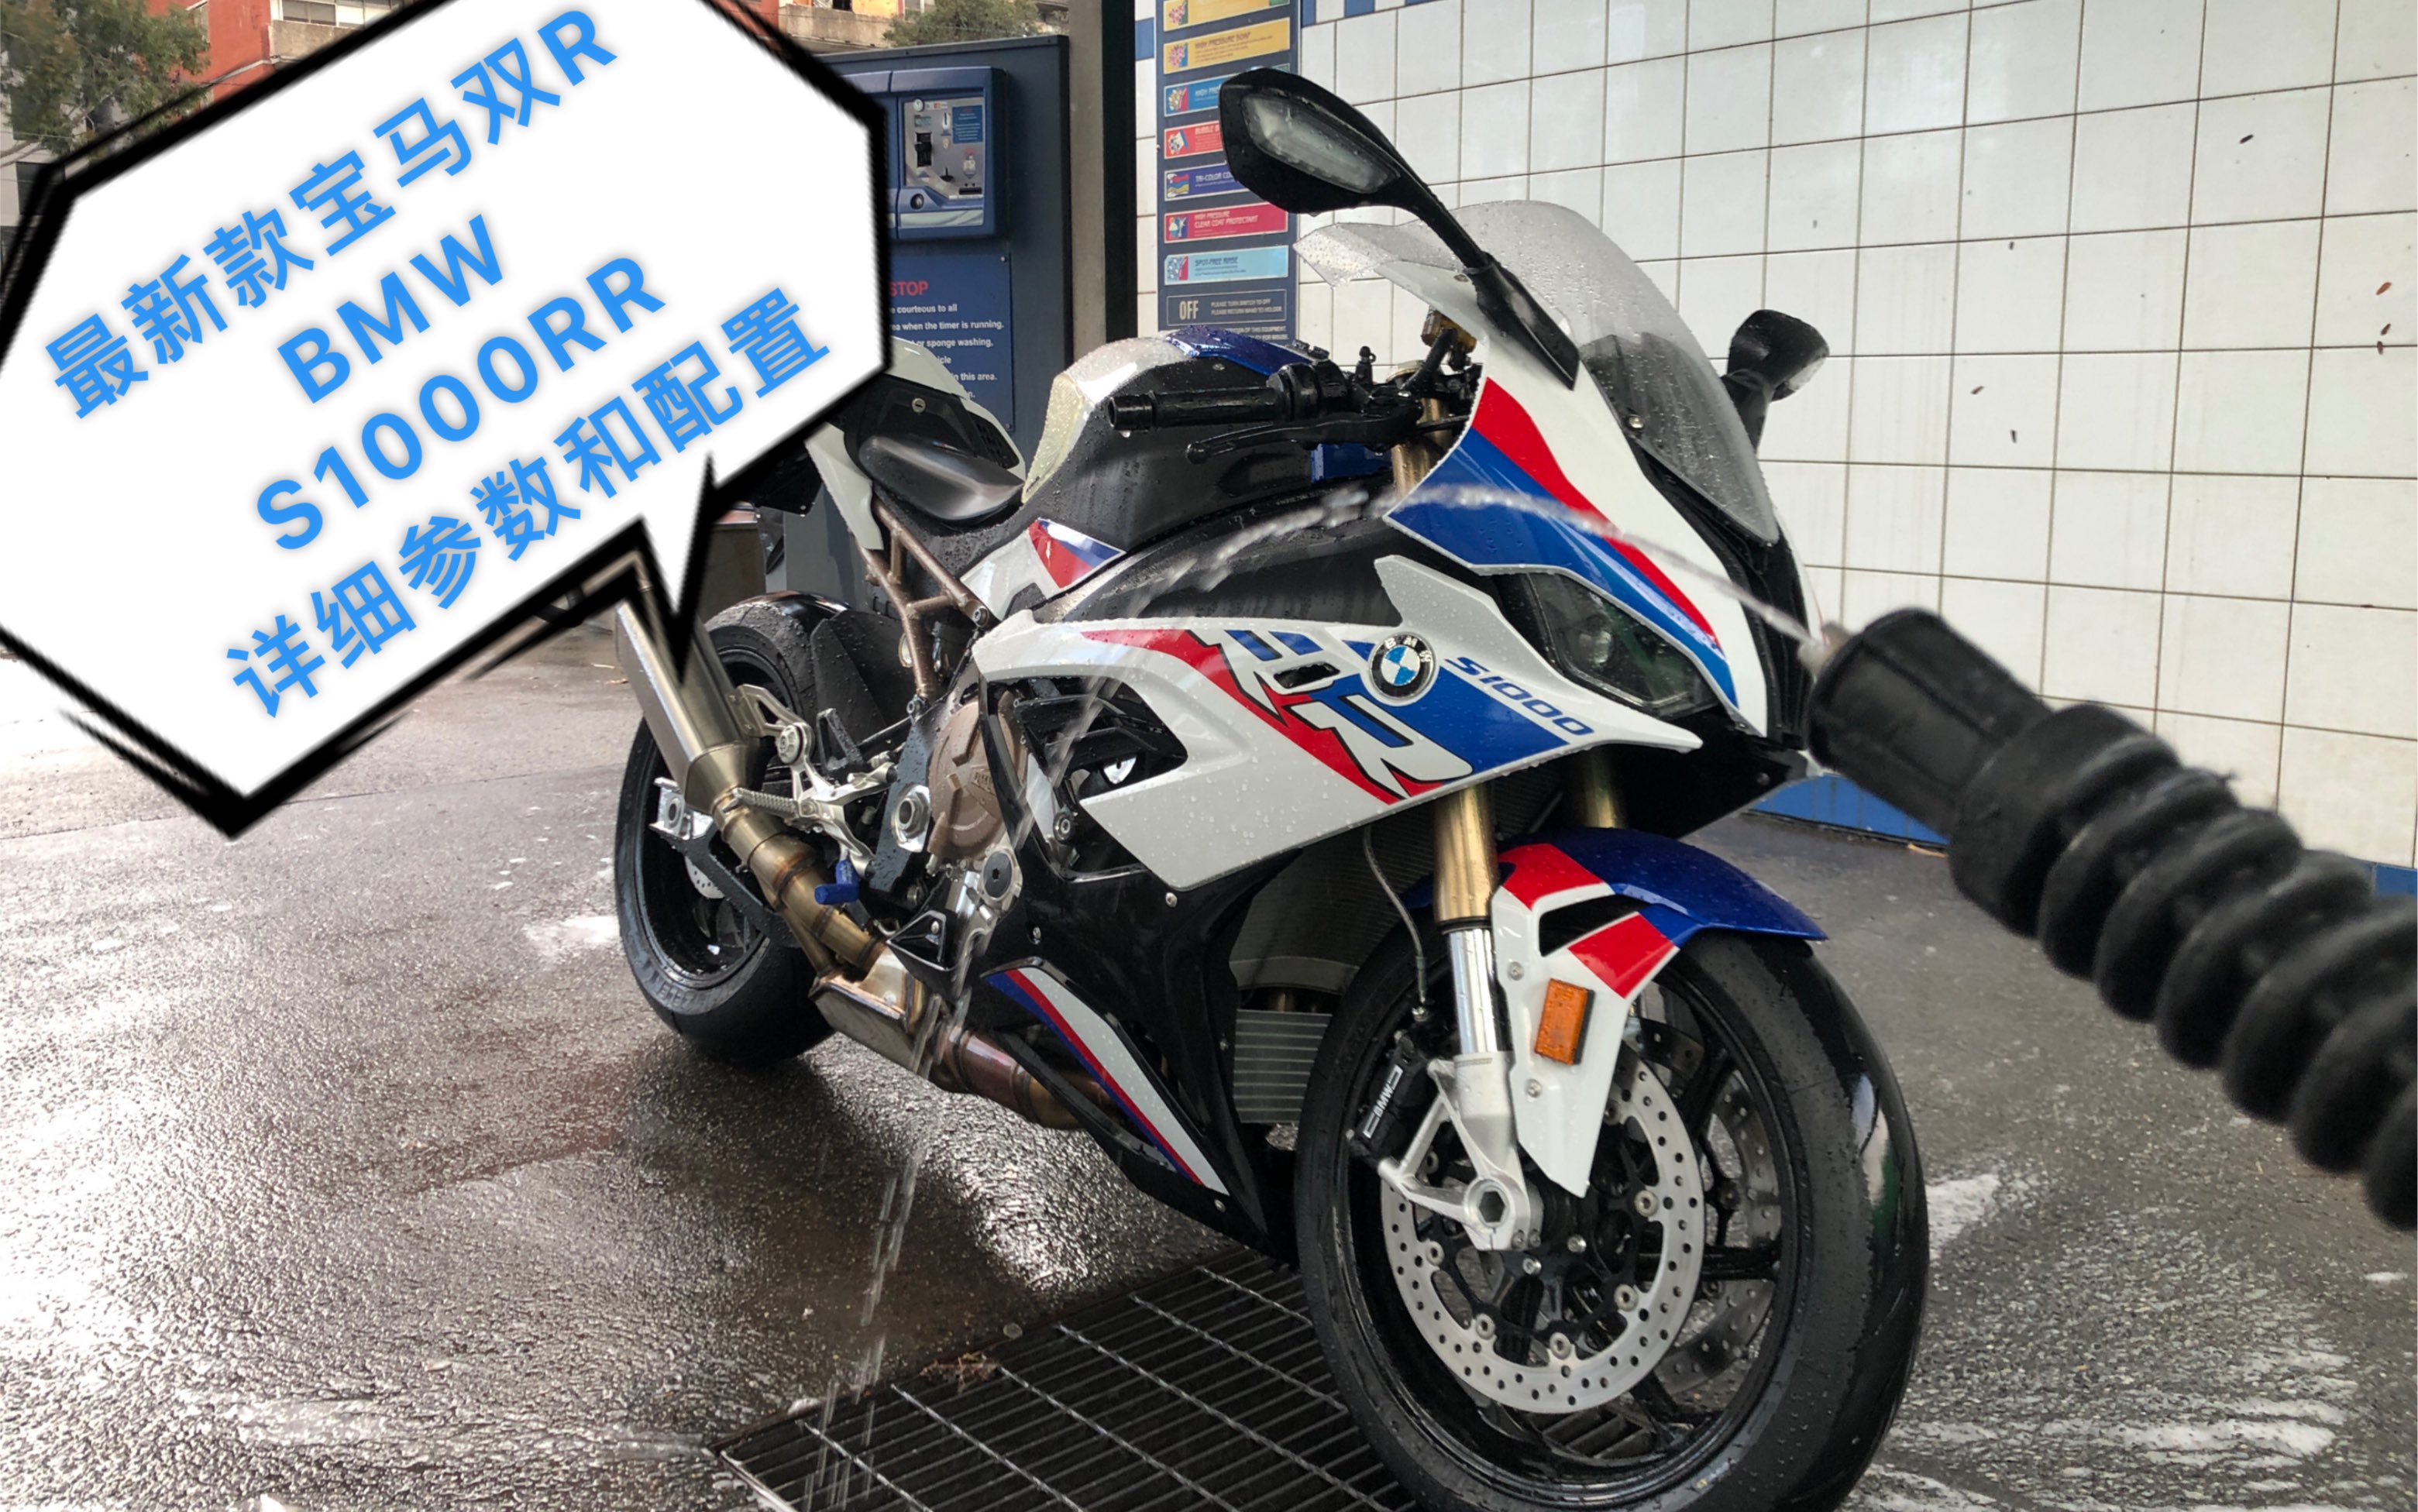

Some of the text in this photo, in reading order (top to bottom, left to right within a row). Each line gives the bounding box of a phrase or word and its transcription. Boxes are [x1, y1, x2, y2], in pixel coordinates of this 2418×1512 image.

[889, 280, 929, 297] STOP
[896, 305, 937, 314] courteous
[1179, 300, 1199, 320] OFF
[902, 322, 924, 331] when
[924, 321, 937, 330] the
[970, 319, 1005, 330] running.
[927, 340, 956, 349] sponge
[961, 372, 975, 380] this
[1444, 656, 1595, 737] S1000
[1373, 1083, 1394, 1118] BMW
